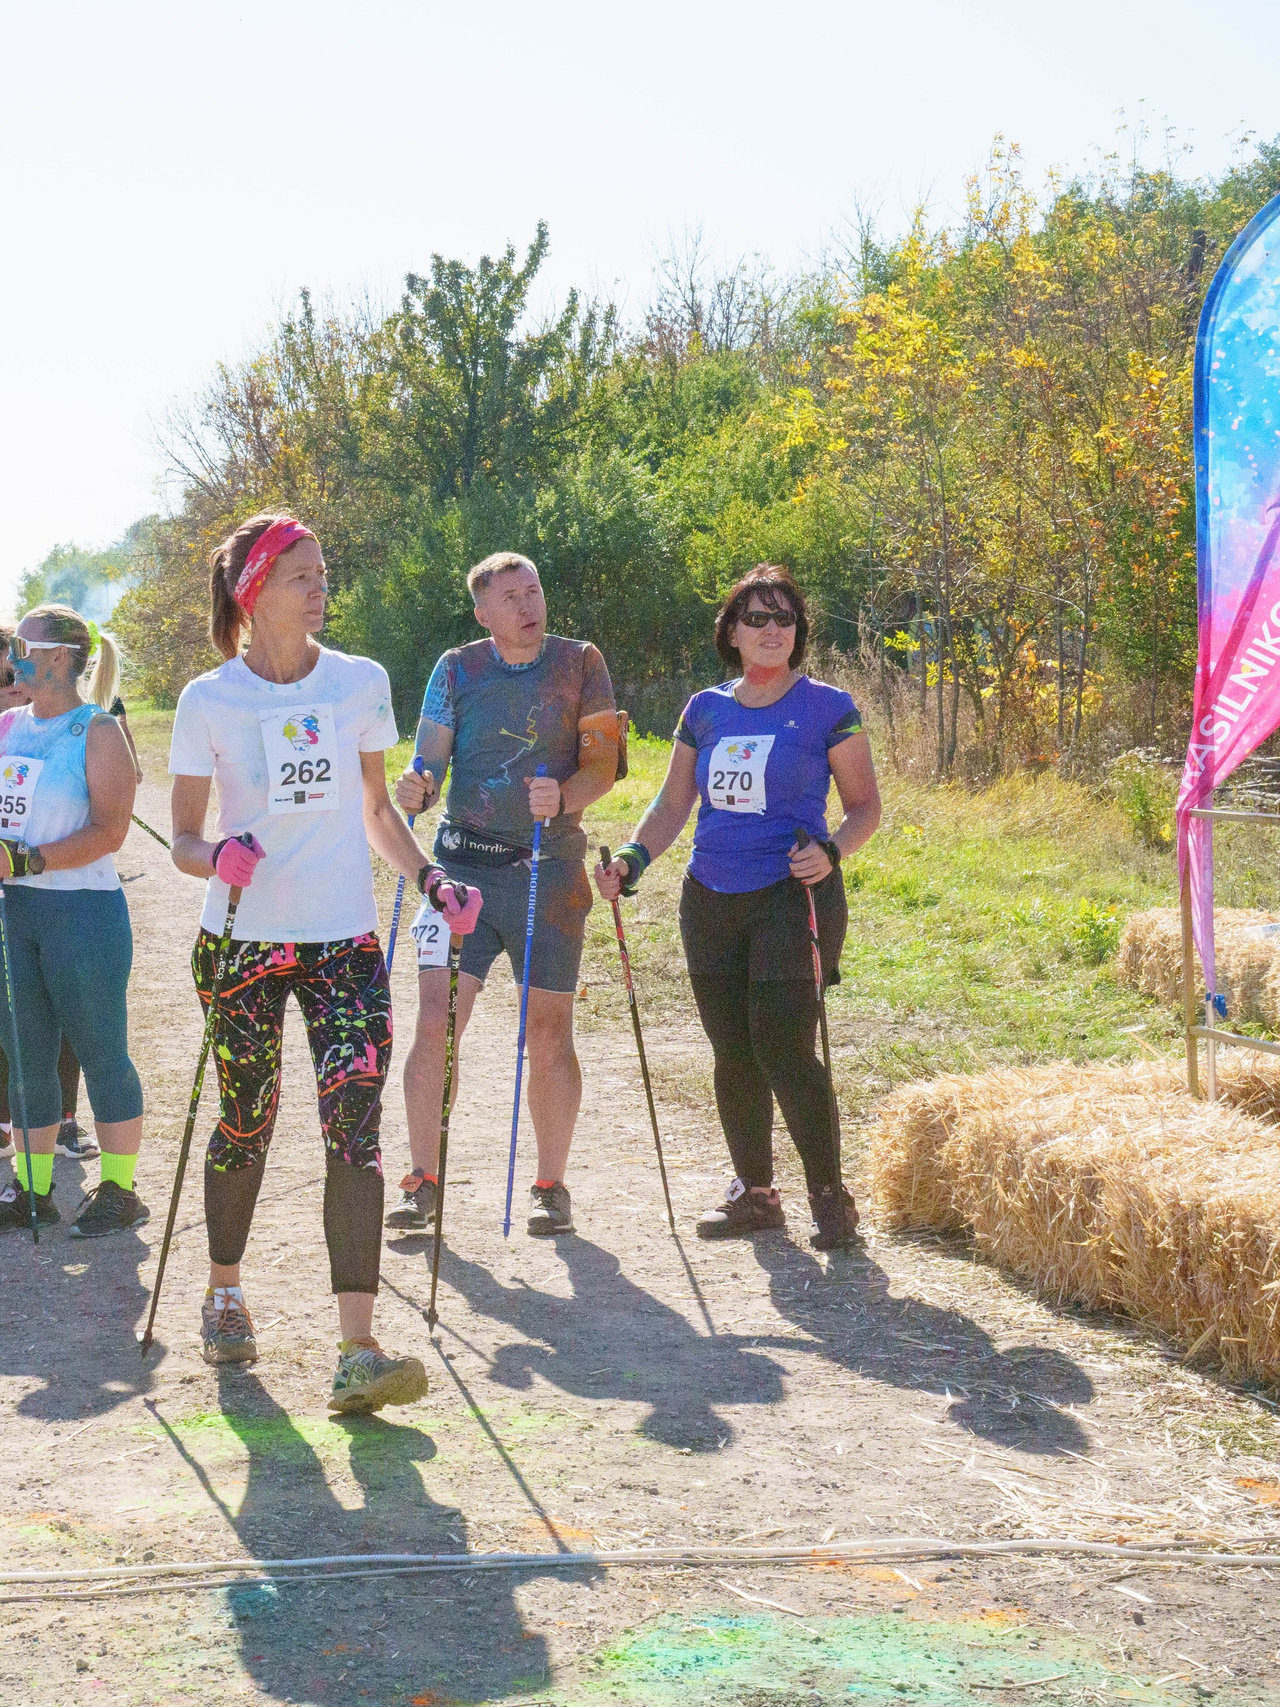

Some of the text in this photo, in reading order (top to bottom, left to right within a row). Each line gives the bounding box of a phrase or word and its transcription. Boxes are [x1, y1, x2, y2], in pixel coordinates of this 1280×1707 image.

[281, 758, 331, 786] 262
[713, 770, 753, 791] 270
[469, 841, 514, 853] nordic
[392, 872, 406, 929] ordicpro
[526, 872, 538, 936] nordicpro
